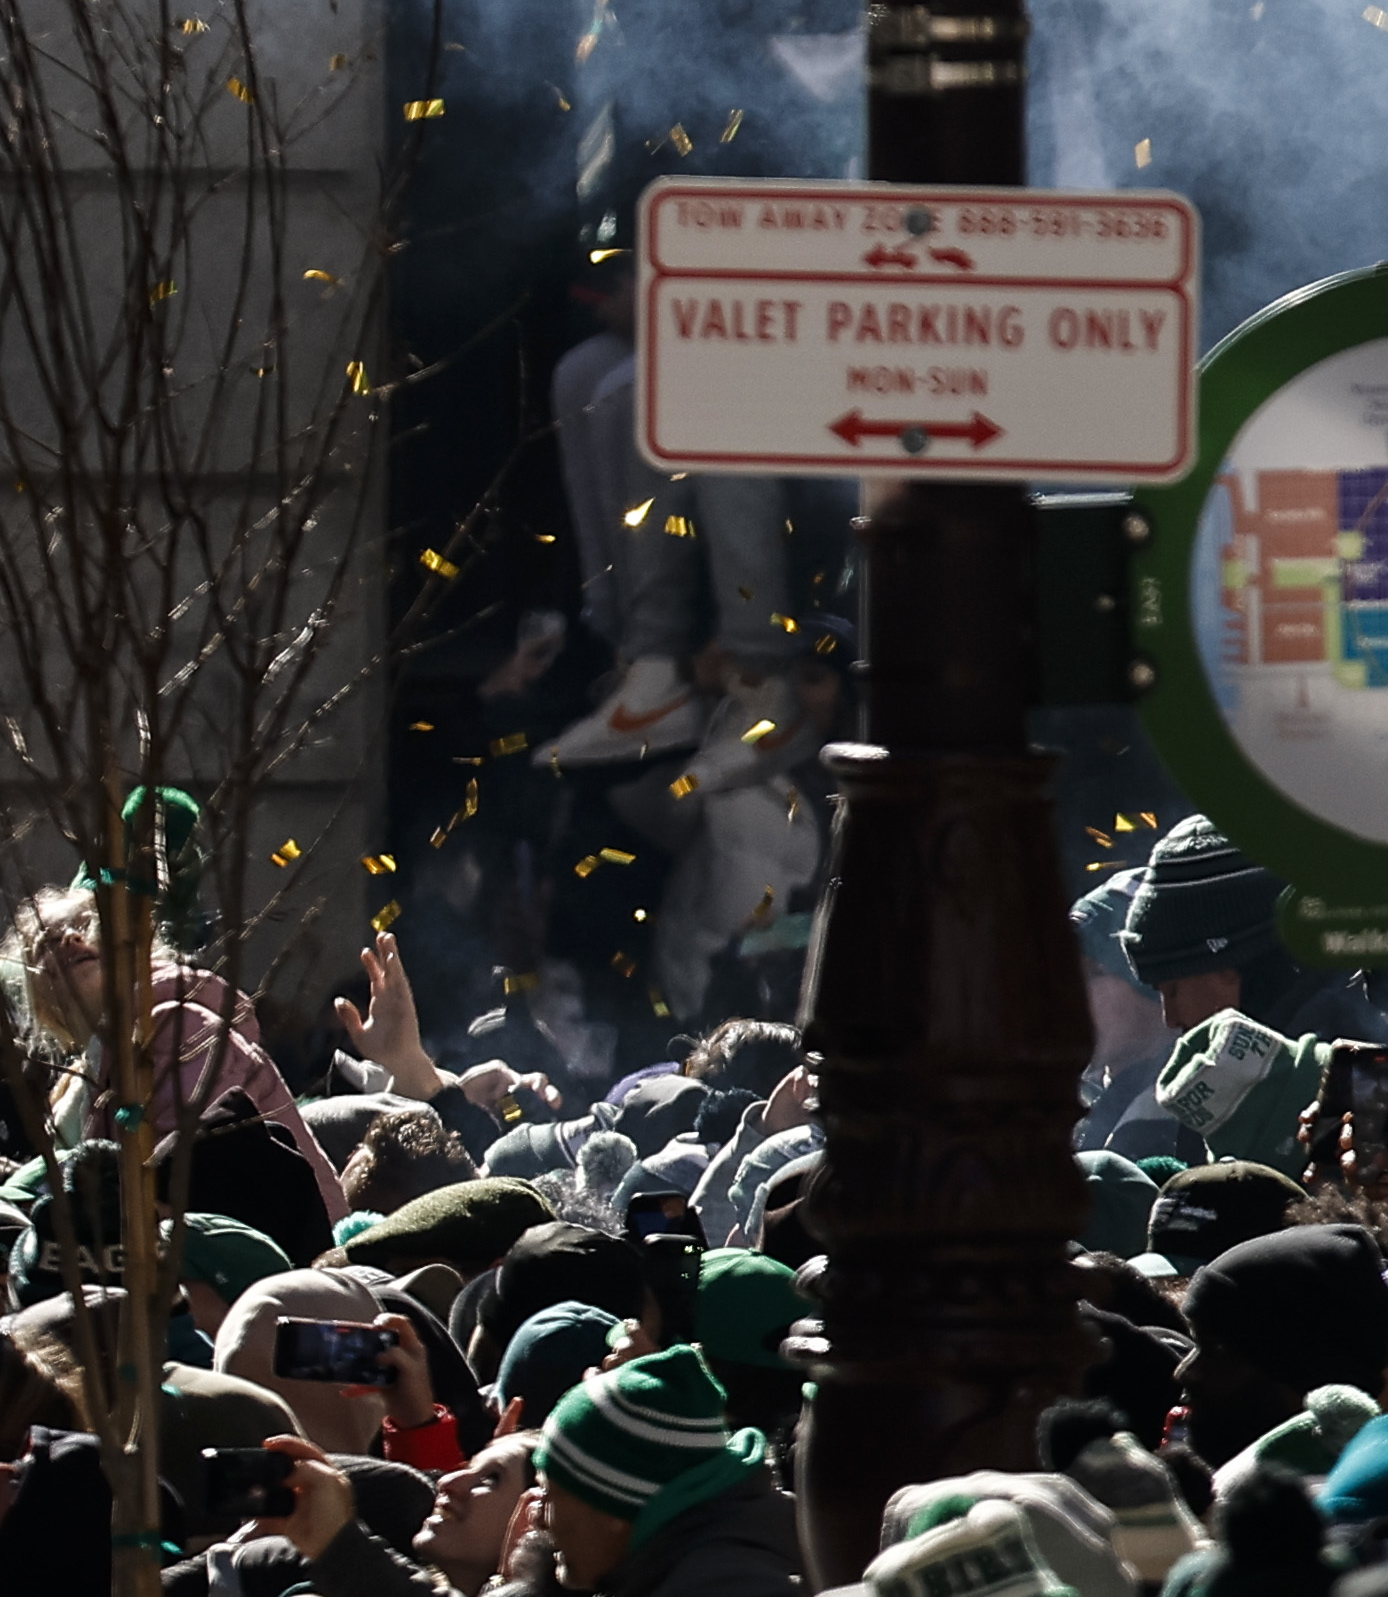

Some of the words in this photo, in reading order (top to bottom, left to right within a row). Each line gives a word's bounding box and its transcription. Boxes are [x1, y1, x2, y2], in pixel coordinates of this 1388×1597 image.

[676, 201, 744, 230] TOW
[758, 204, 847, 232] AWAY
[861, 206, 942, 235] ZOE
[670, 298, 806, 343] VALET
[826, 301, 1026, 348] PARKING
[1047, 307, 1168, 352] ONLY
[845, 365, 990, 397] MON-SUN
[1178, 1080, 1215, 1116] FOR
